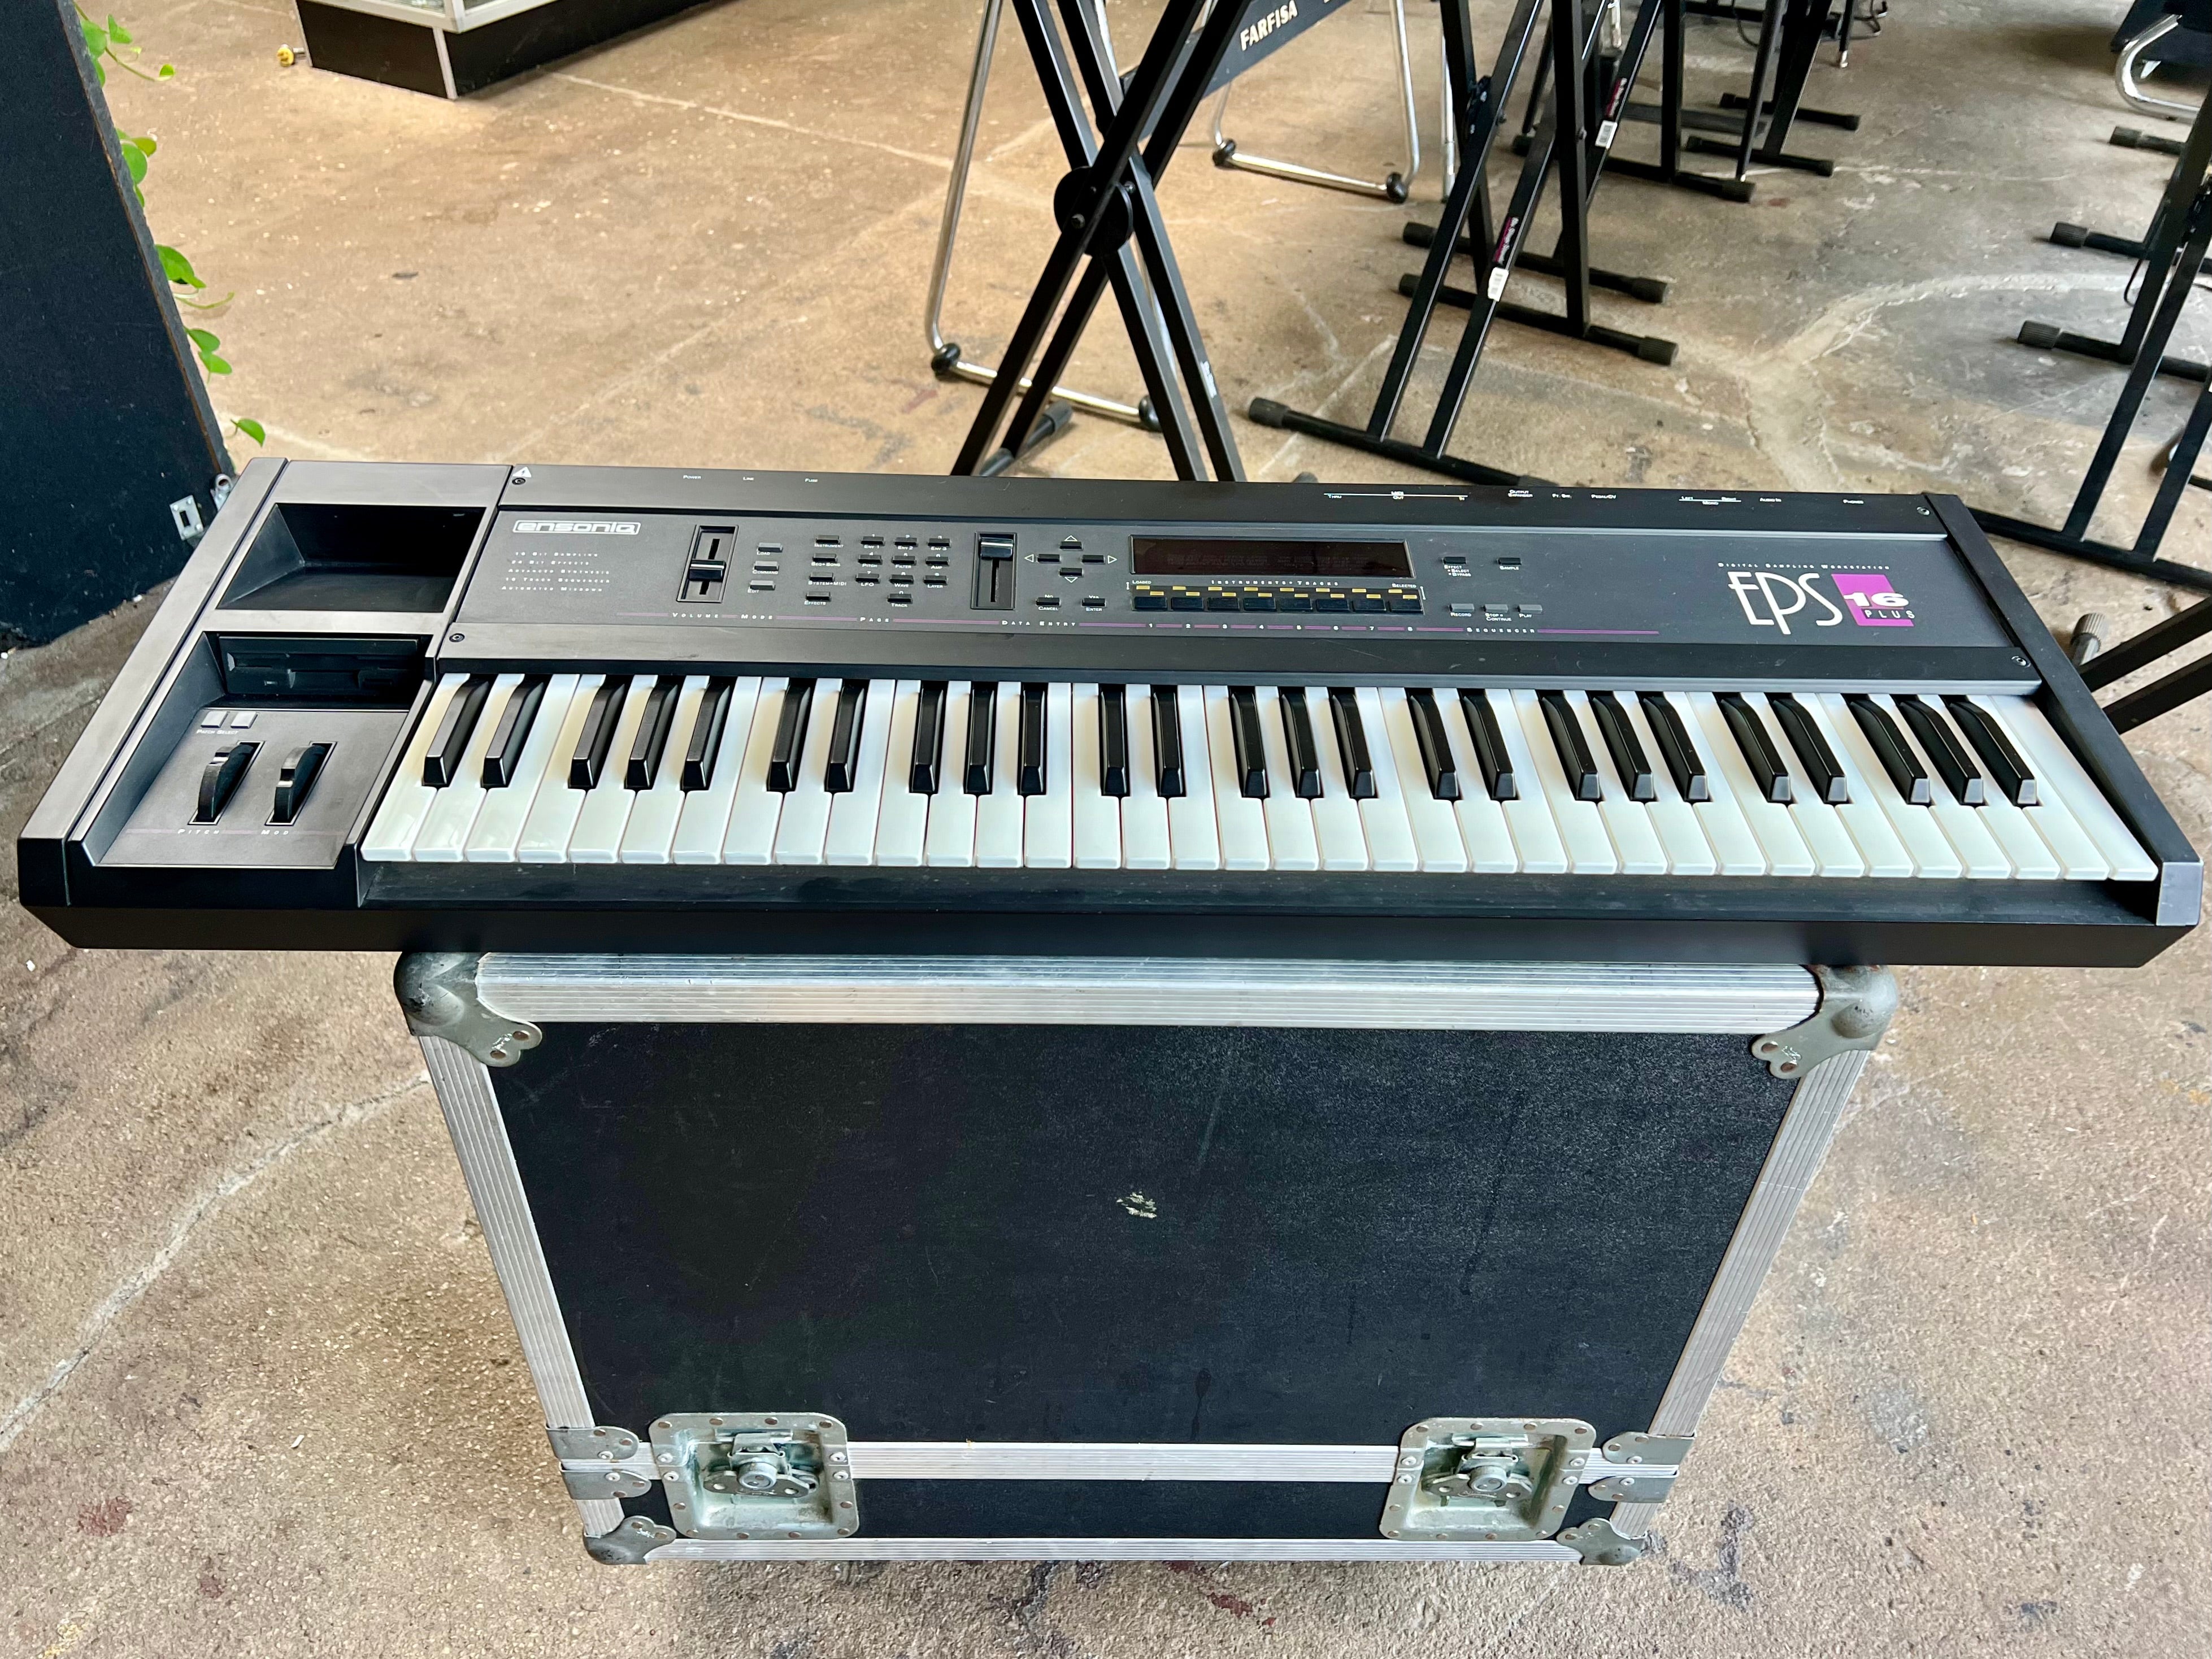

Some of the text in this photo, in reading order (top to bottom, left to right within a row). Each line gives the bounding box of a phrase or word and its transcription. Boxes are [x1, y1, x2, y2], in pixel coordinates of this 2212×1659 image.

[1240, 0, 1298, 51] FARFISA
[1727, 571, 1909, 635] EPS 16
[1864, 609, 1915, 620] PLUS
